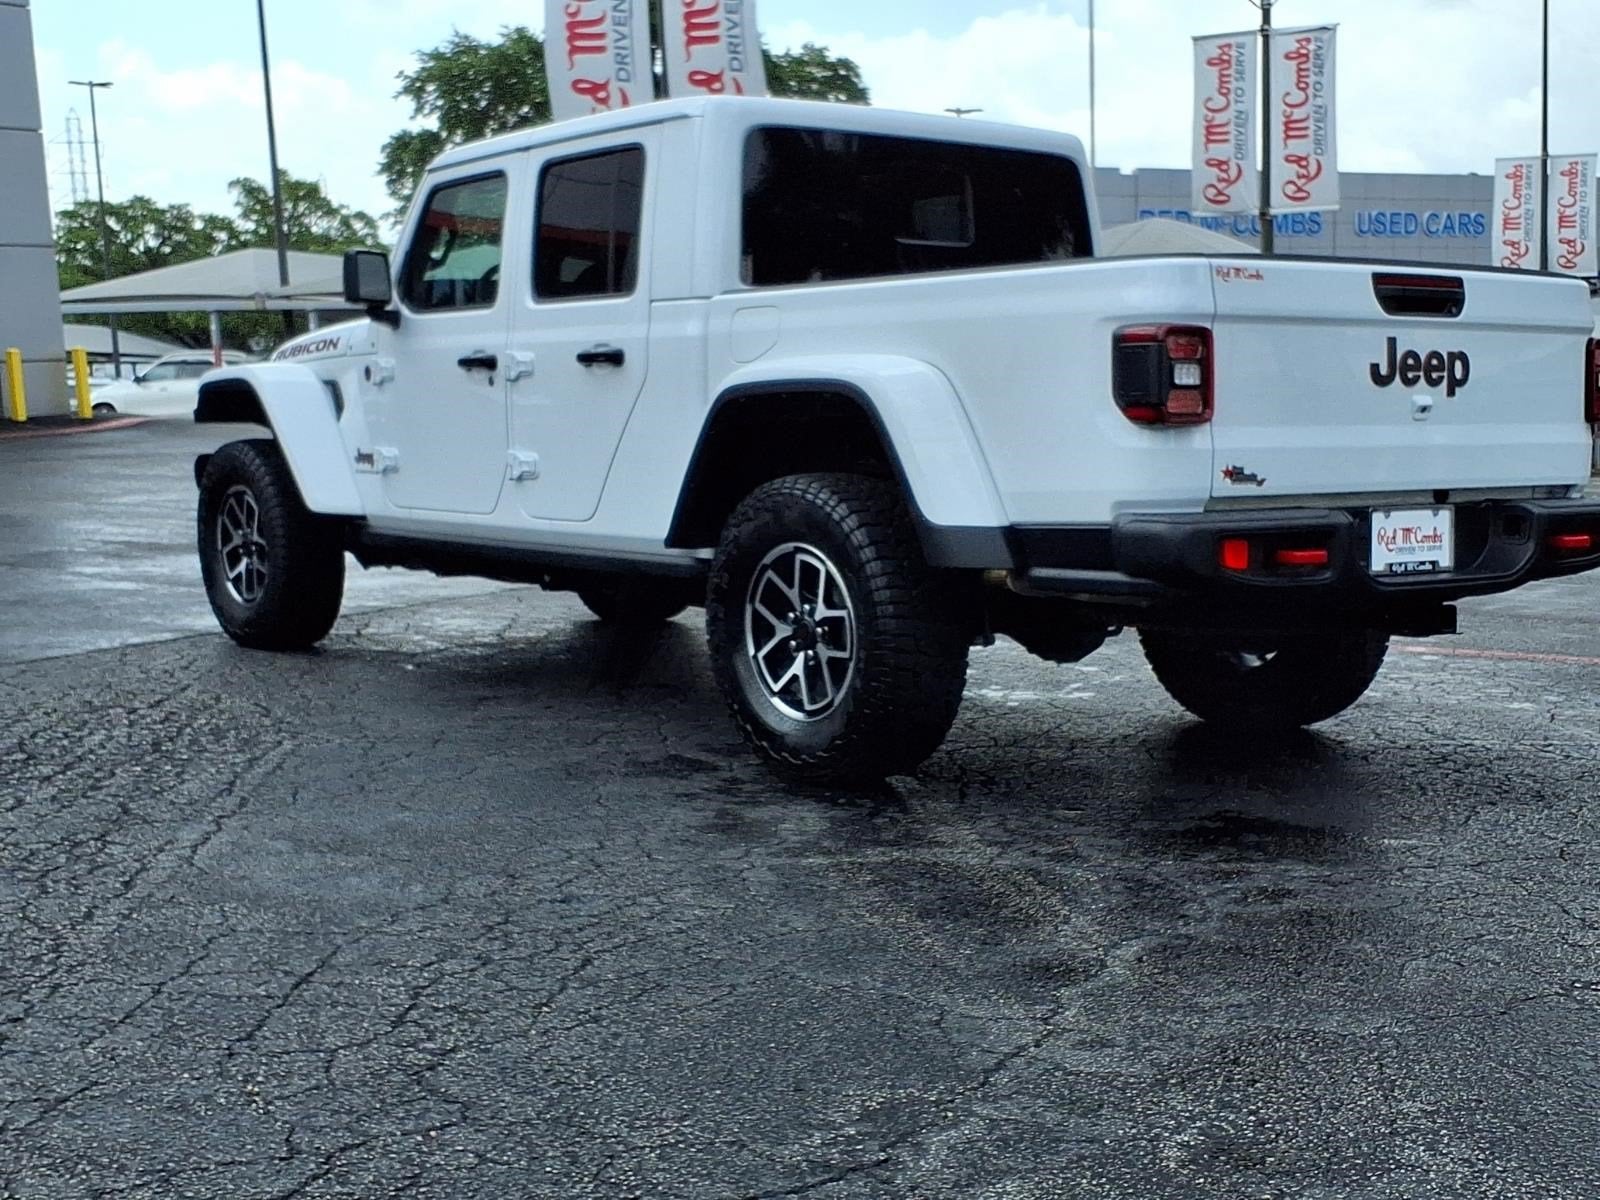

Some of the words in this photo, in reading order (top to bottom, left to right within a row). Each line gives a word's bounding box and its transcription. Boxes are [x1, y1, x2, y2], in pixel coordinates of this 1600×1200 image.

[1235, 42, 1246, 82] SERVE
[1203, 43, 1233, 152] McCombs
[1234, 87, 1245, 106] TO
[1282, 37, 1312, 150] McCombs
[1313, 81, 1324, 101] TO
[1234, 110, 1245, 161] DRIVEN
[1313, 104, 1325, 156] DRIVEN
[1203, 157, 1242, 205] Red
[1282, 154, 1322, 203] Red
[1502, 164, 1524, 236] McCombs
[1557, 161, 1579, 234] McCombs
[1355, 211, 1419, 237] USED
[1423, 211, 1486, 237] CARS
[1501, 240, 1529, 268] Red
[1557, 238, 1585, 269] Red
[273, 336, 341, 361] RUBICON
[1370, 336, 1470, 398] Jeep
[1377, 526, 1397, 553] Red
[1398, 526, 1443, 546] McCombs
